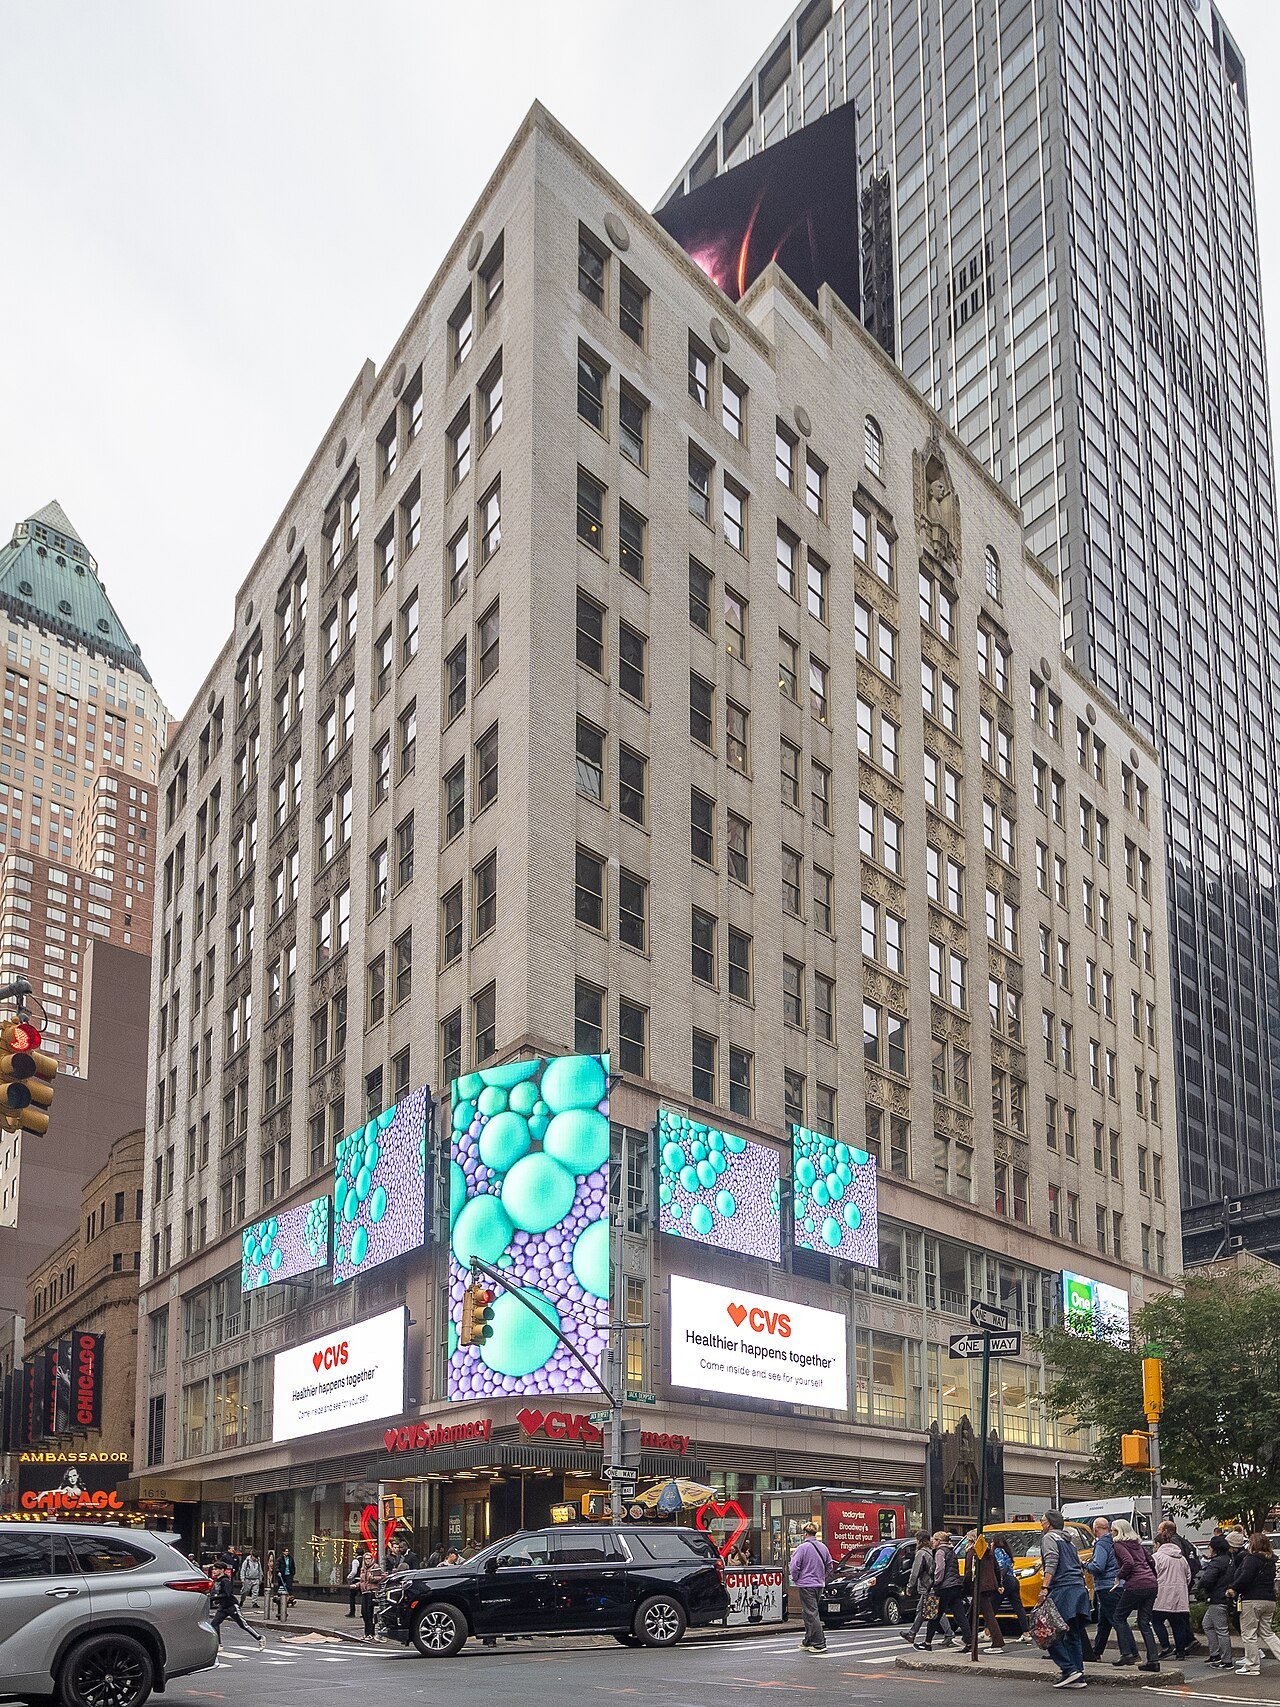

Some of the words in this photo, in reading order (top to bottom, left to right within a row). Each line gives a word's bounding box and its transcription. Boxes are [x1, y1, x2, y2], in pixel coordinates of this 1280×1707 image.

[1071, 1291, 1091, 1311] One
[749, 1307, 792, 1338] CVS
[975, 1308, 987, 1321] ONE
[992, 1315, 1005, 1327] WAY
[686, 1329, 739, 1352] Healthier
[741, 1339, 787, 1361] happens
[958, 1341, 979, 1352] ONE
[991, 1338, 1015, 1350] WAY
[323, 1340, 349, 1370] CVS
[77, 1335, 96, 1424] CHICAGO
[700, 1358, 725, 1372] Come
[726, 1364, 750, 1376] inside
[752, 1368, 766, 1379] and
[768, 1372, 781, 1381] see
[783, 1371, 793, 1383] for
[292, 1384, 318, 1401] Healthier
[318, 1378, 345, 1395] happens
[20, 1452, 128, 1462] AMBASSADOR
[21, 1490, 124, 1509] CHICAGO
[143, 1489, 166, 1499] 1619
[834, 1531, 847, 1540] best
[839, 1522, 869, 1532] Broadway's
[726, 1572, 782, 1588] CHICAGO
